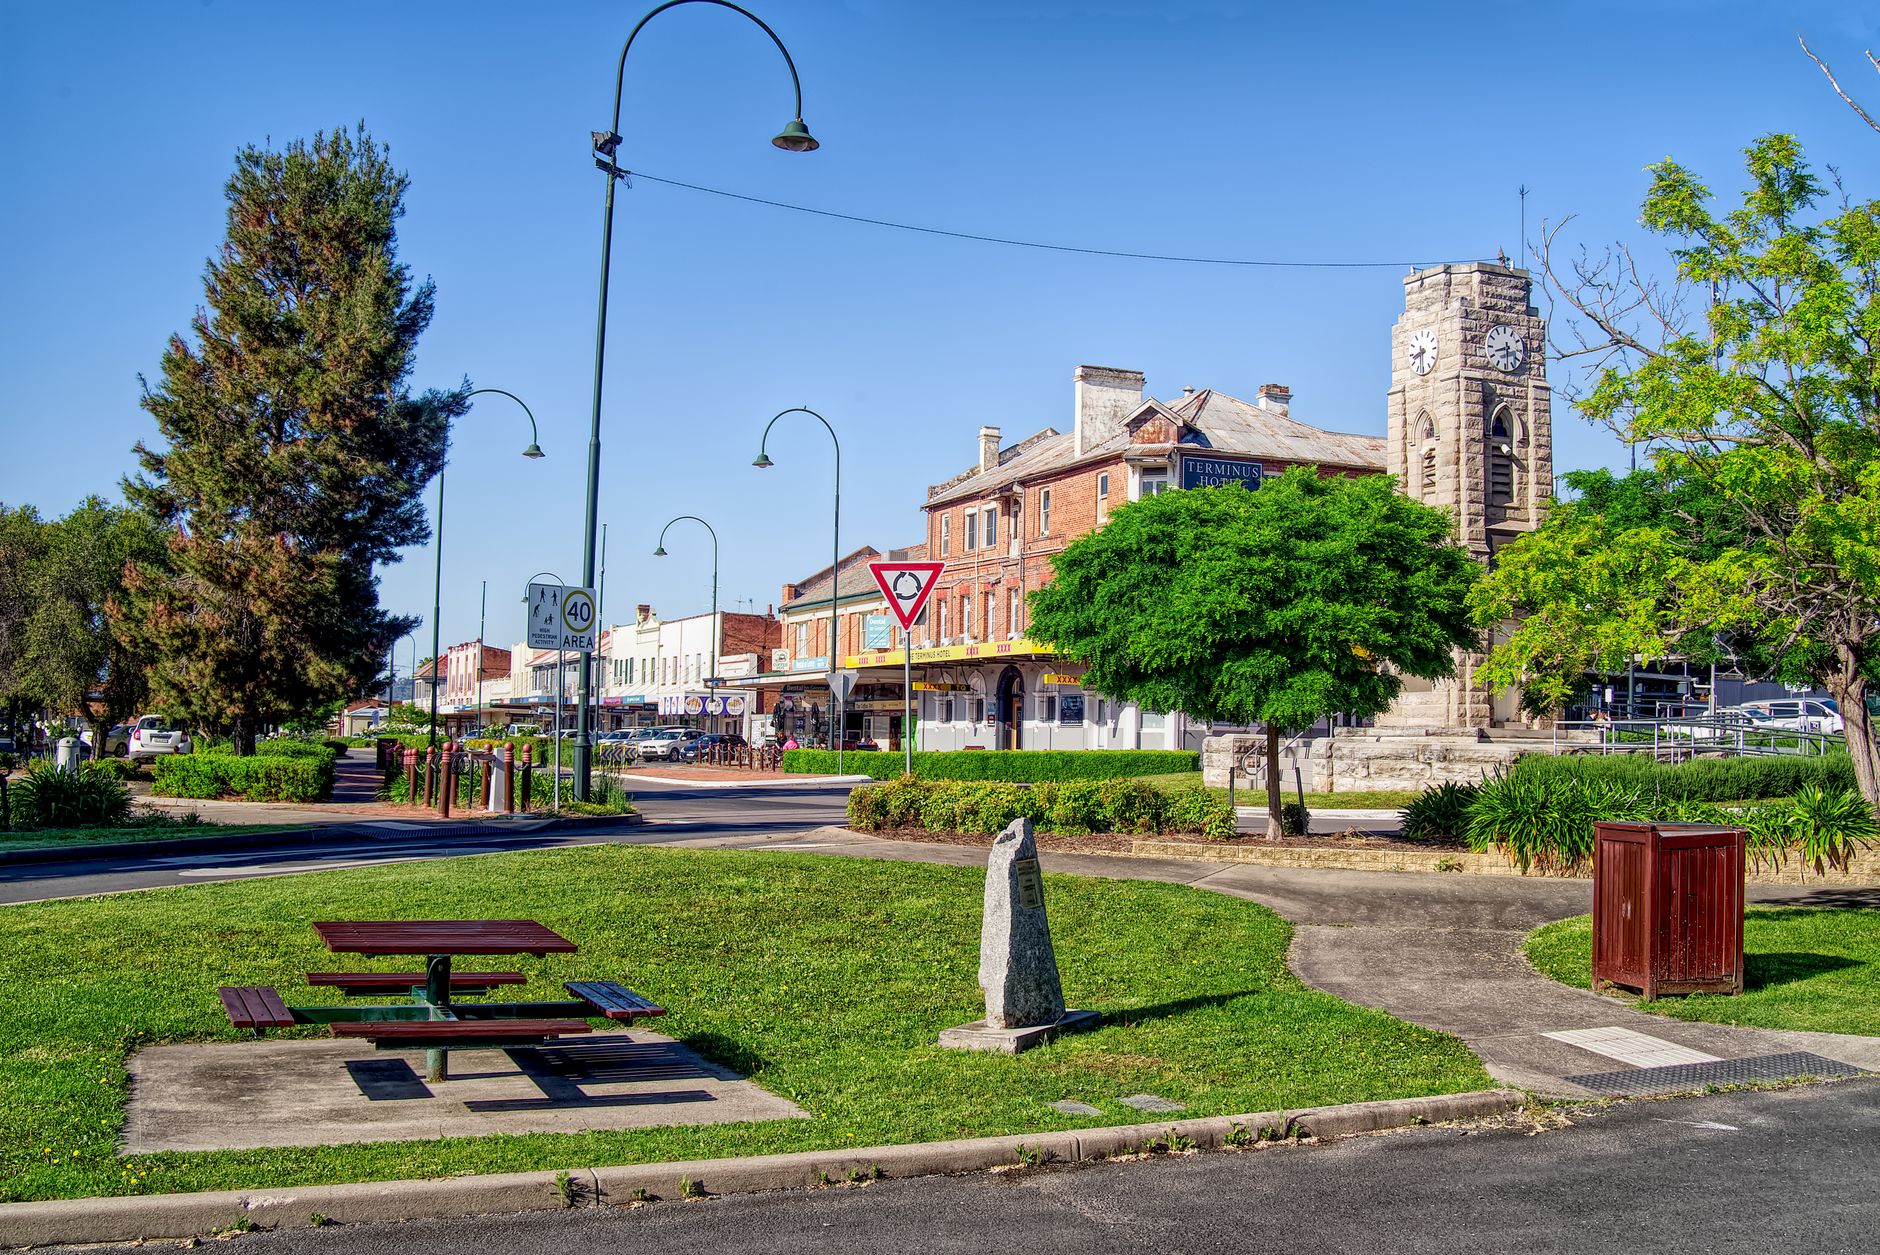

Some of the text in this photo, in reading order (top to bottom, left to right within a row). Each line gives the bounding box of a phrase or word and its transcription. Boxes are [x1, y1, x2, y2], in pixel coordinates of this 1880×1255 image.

[1187, 461, 1259, 478] TERMINUS
[567, 601, 591, 622] 40
[562, 635, 594, 649] AREA
[915, 651, 935, 659] TERMINUS
[937, 649, 951, 657] HOTEL
[997, 643, 1011, 653] XXXX
[1057, 675, 1078, 684] XXXX
